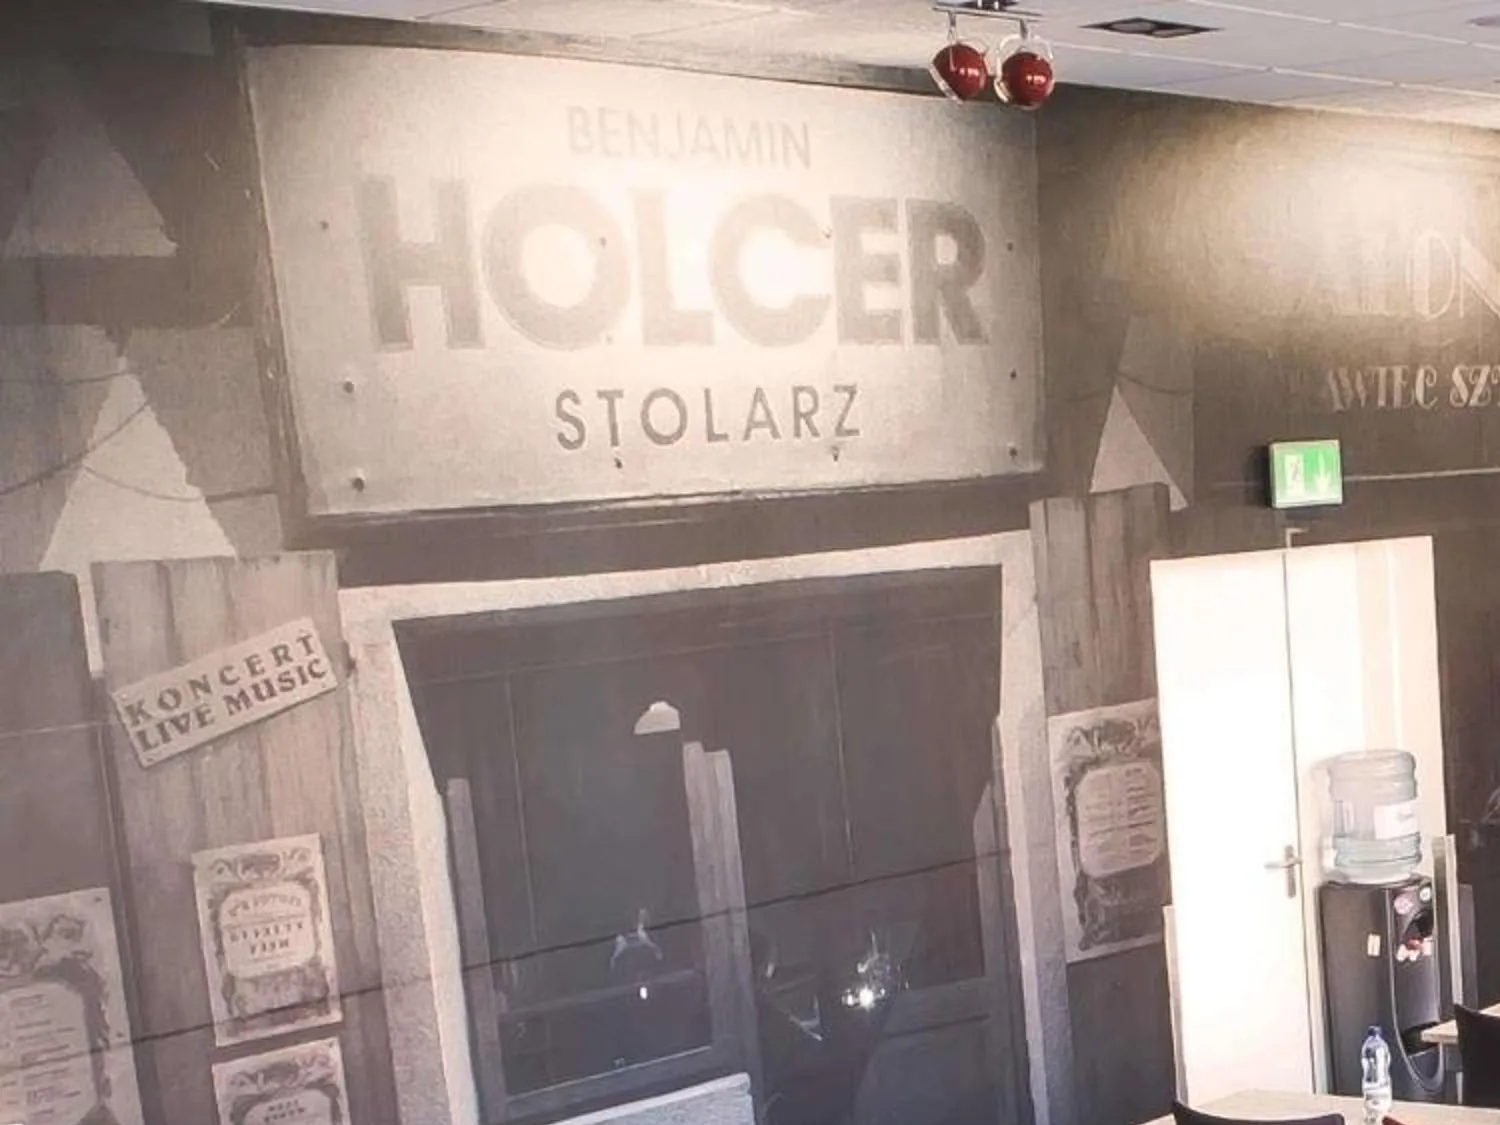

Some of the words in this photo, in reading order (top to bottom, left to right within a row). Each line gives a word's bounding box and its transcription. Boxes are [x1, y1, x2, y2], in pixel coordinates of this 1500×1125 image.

[566, 104, 812, 171] BENJAMIN
[353, 172, 989, 353] HOLCER
[554, 383, 861, 451] STOLARZ
[123, 632, 314, 728] KONCERT
[136, 703, 215, 751] LIVE
[222, 657, 327, 716] MUSIC
